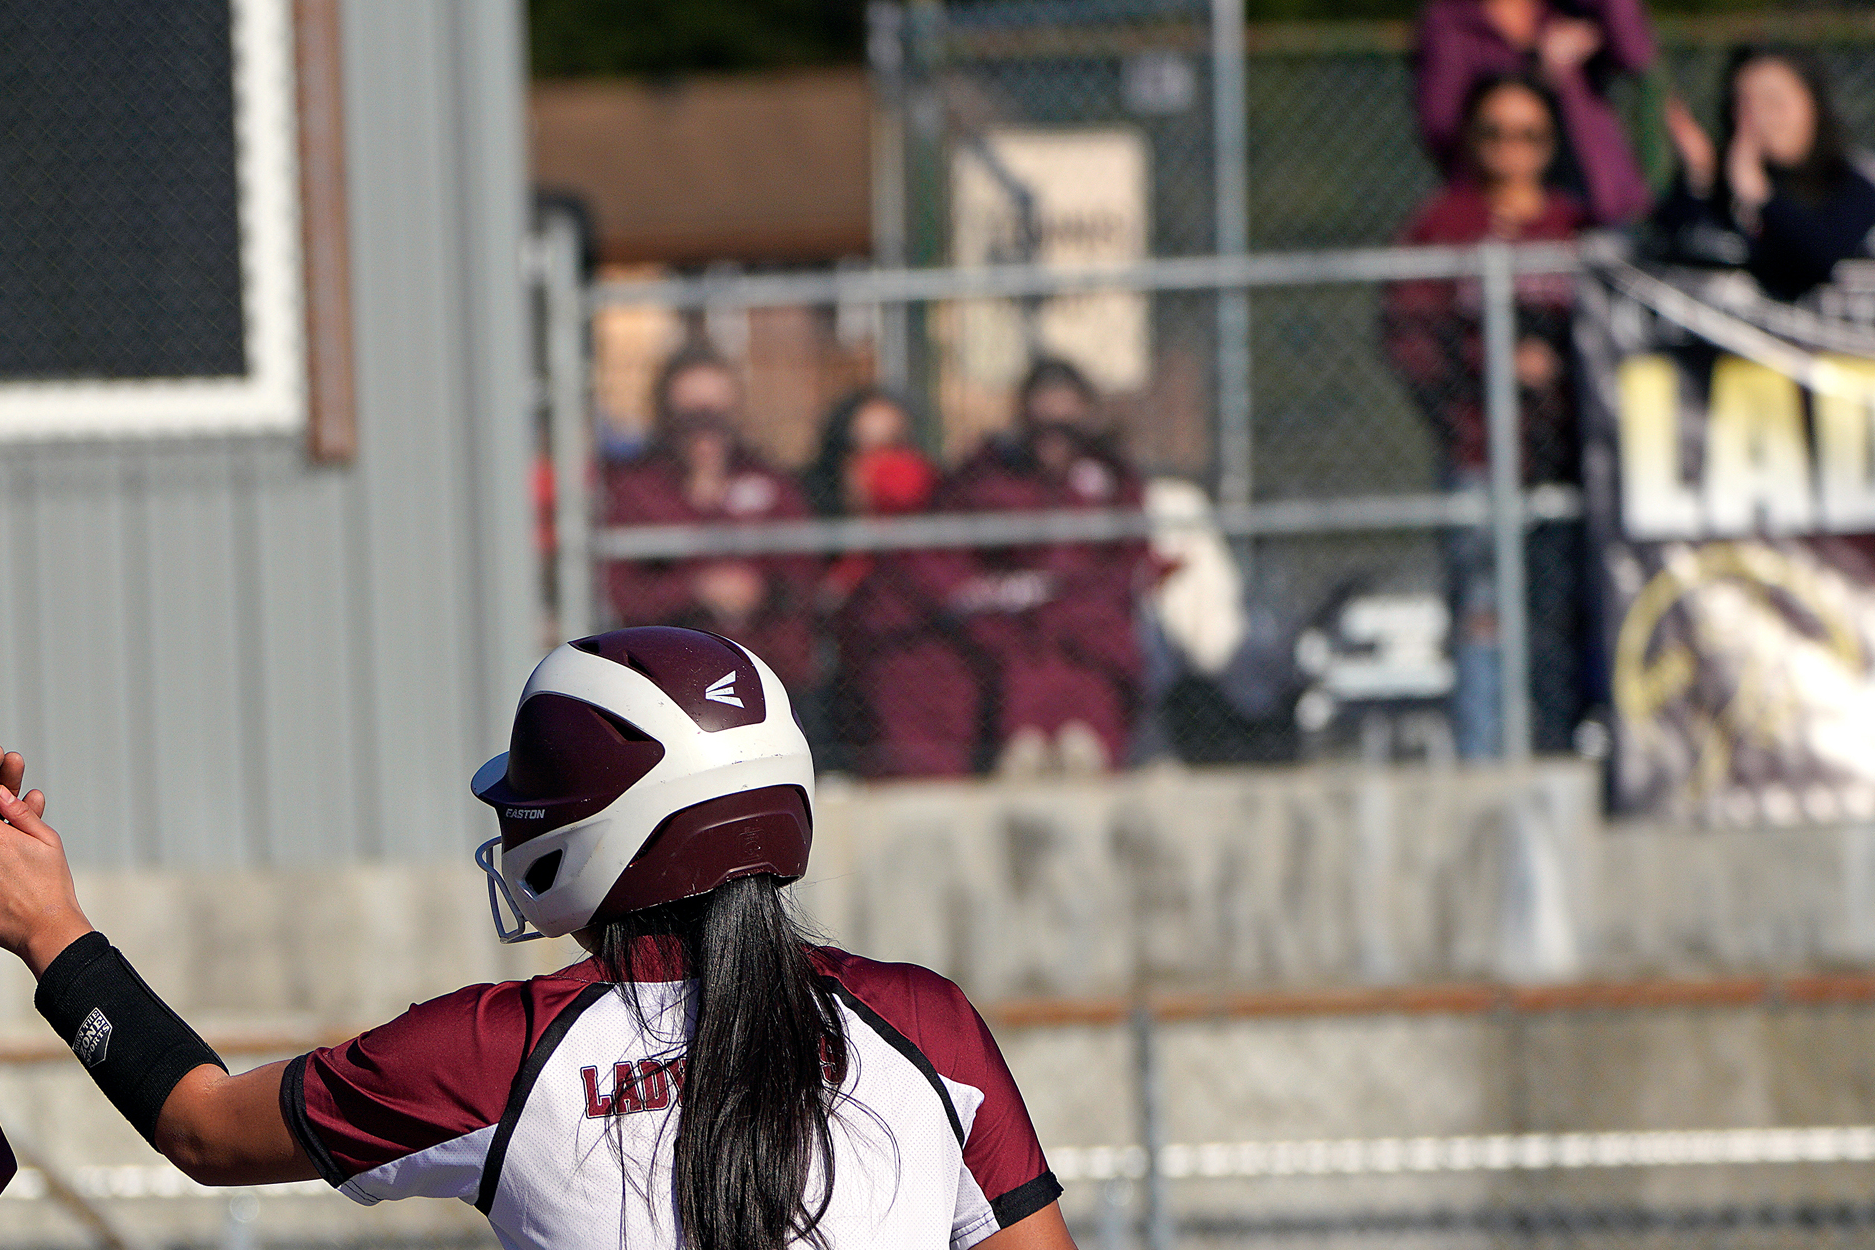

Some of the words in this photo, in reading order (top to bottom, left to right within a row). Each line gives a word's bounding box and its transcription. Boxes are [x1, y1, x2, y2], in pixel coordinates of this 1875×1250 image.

[505, 808, 546, 819] EASTON
[82, 1010, 99, 1029] THE
[80, 1015, 106, 1059] ZONE
